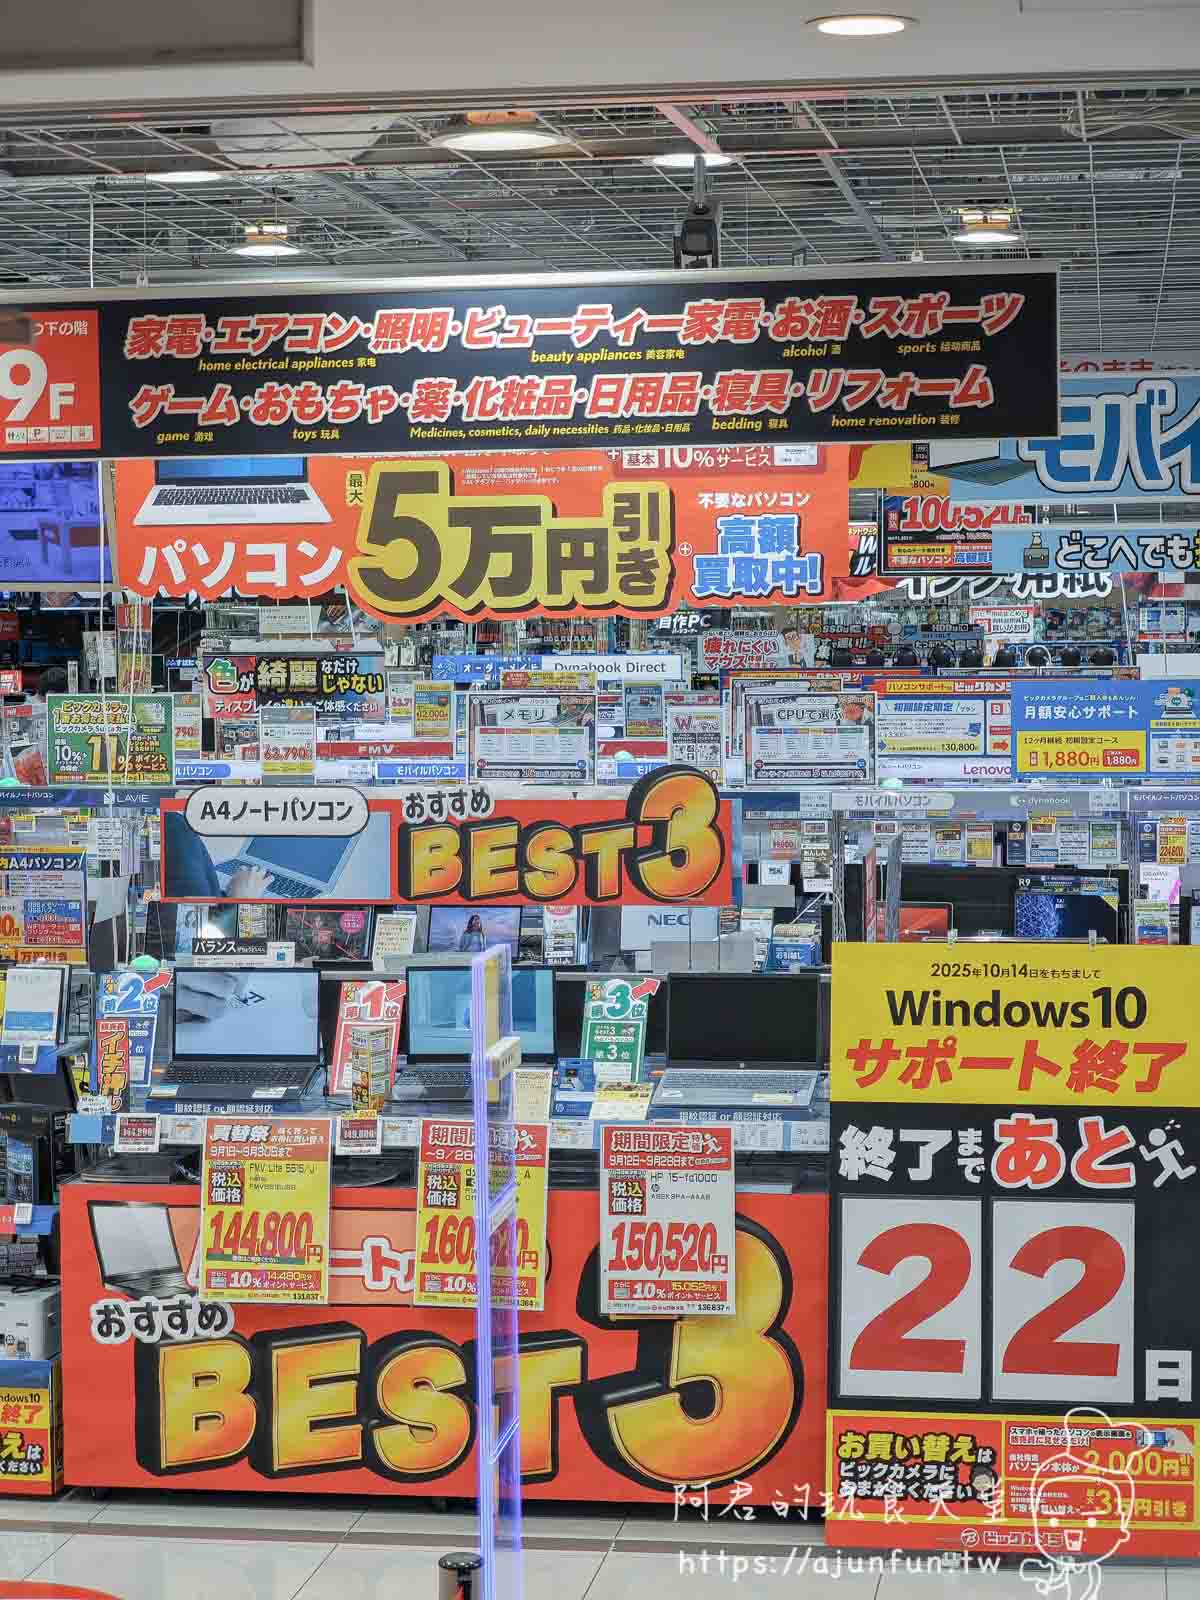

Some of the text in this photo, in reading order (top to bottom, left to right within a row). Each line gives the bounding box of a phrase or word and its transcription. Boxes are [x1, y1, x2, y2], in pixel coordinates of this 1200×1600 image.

[783, 344, 827, 358] alcohol
[897, 343, 937, 355] sports
[531, 351, 573, 365] beauty
[576, 349, 642, 364] appliances
[199, 361, 232, 372] home
[234, 359, 289, 371] electrical
[291, 358, 354, 372] appliances
[711, 417, 762, 431] bedding
[831, 415, 866, 427] home
[868, 413, 936, 426] renovation
[157, 432, 190, 445] game
[293, 428, 318, 440] toys
[409, 427, 467, 440] Medicines,
[468, 426, 523, 439] cosmetics,
[525, 424, 551, 438] daily
[552, 424, 609, 436] necessities
[716, 453, 772, 467] サービス
[347, 472, 364, 503] 最大
[698, 491, 812, 510] 不要なパソコン
[717, 515, 798, 553] 高額
[138, 537, 343, 588] パソコン
[658, 614, 712, 630] 自作PC
[625, 661, 667, 673] Direct
[503, 708, 545, 721] メモリ
[1024, 705, 1138, 720] 月額安心サポート
[357, 744, 394, 754] FMV
[116, 794, 150, 803] LAVIE
[402, 788, 493, 821] おすすめ
[200, 796, 353, 822] A4ノートパソコン
[647, 911, 690, 926] NEC
[930, 962, 1101, 980] 2025年10月14日をもちまして
[846, 1034, 1189, 1095] サポート終了
[719, 1112, 731, 1121] or
[211, 1172, 242, 1187] 税込
[426, 1174, 458, 1191] 税込
[211, 1188, 242, 1203] 価格
[611, 1182, 643, 1197] 税込
[426, 1190, 458, 1207] 価格
[611, 1199, 643, 1214] 価格
[93, 1299, 233, 1341] おすすめ
[837, 1431, 993, 1464] お買い替えは
[839, 1461, 956, 1480] ビックカメラに
